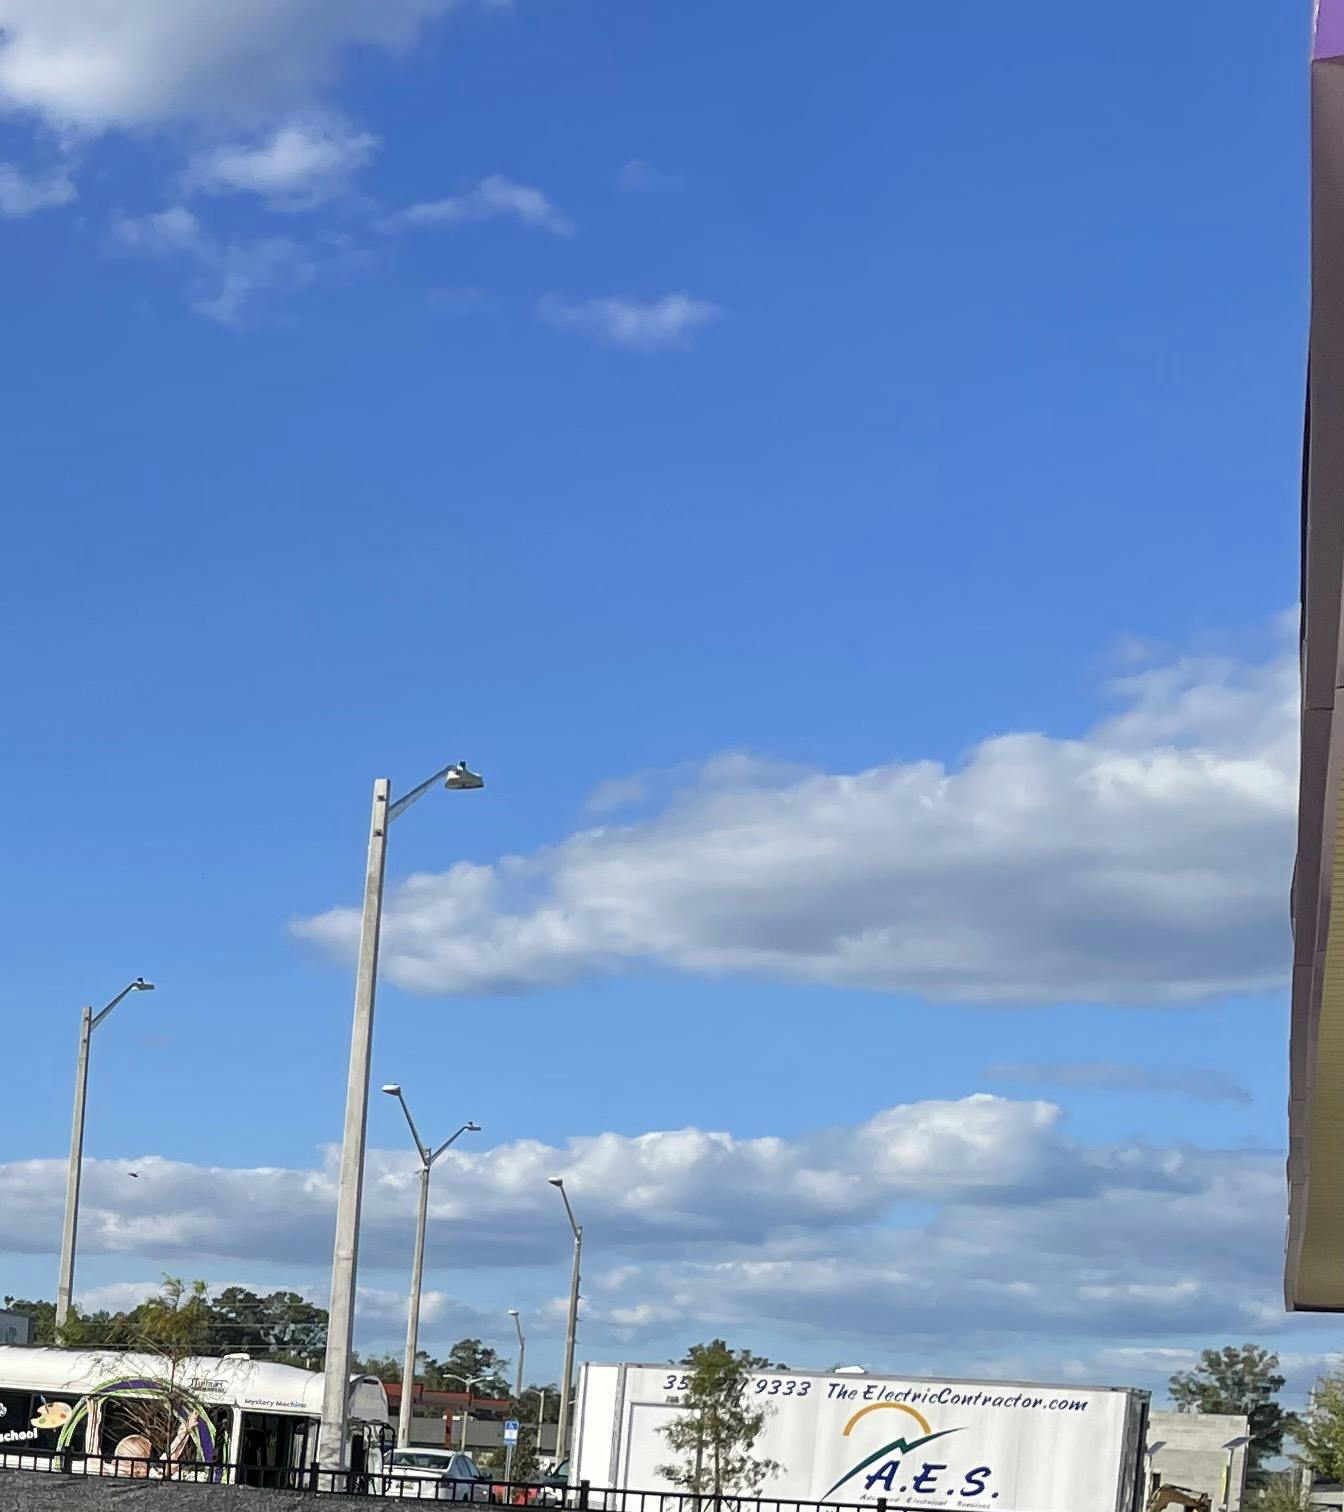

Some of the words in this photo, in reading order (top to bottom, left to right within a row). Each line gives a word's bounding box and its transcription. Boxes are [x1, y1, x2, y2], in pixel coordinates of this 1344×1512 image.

[755, 1379, 811, 1396] 9333
[826, 1383, 858, 1400] The
[862, 1384, 1089, 1412] ElectricContractor.com
